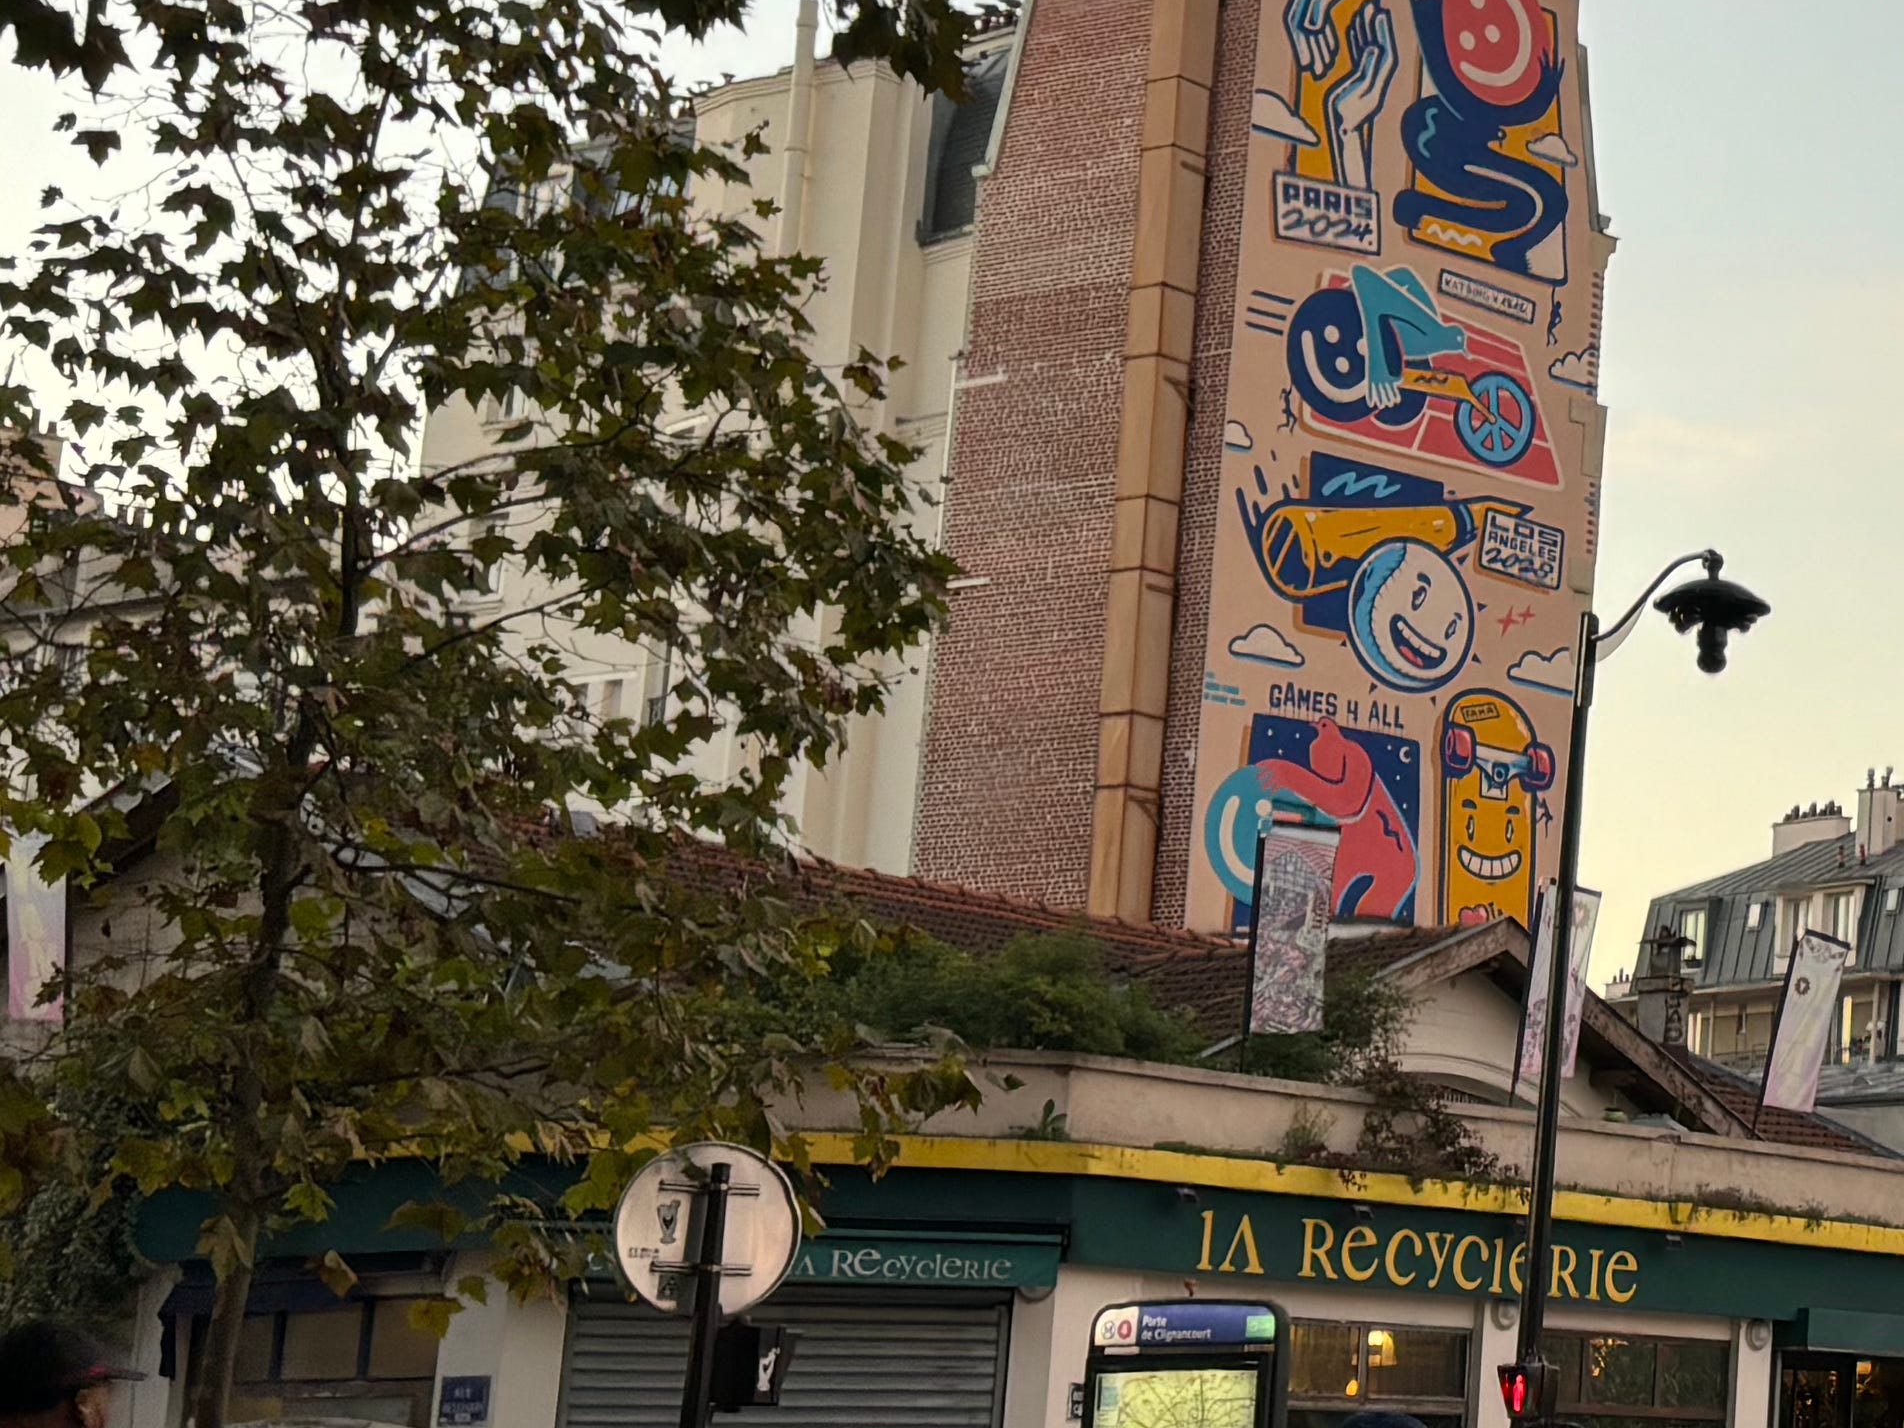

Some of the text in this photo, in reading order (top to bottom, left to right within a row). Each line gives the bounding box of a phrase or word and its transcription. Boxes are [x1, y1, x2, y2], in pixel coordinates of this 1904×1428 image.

[1283, 183, 1372, 220] PARIS
[1488, 531, 1556, 561] ANGELES
[1490, 515, 1558, 547] LOS
[1269, 682, 1404, 729] GAMES 4 ALL
[1141, 1329, 1212, 1342] de Clignancourt
[1143, 1315, 1168, 1328] Porte
